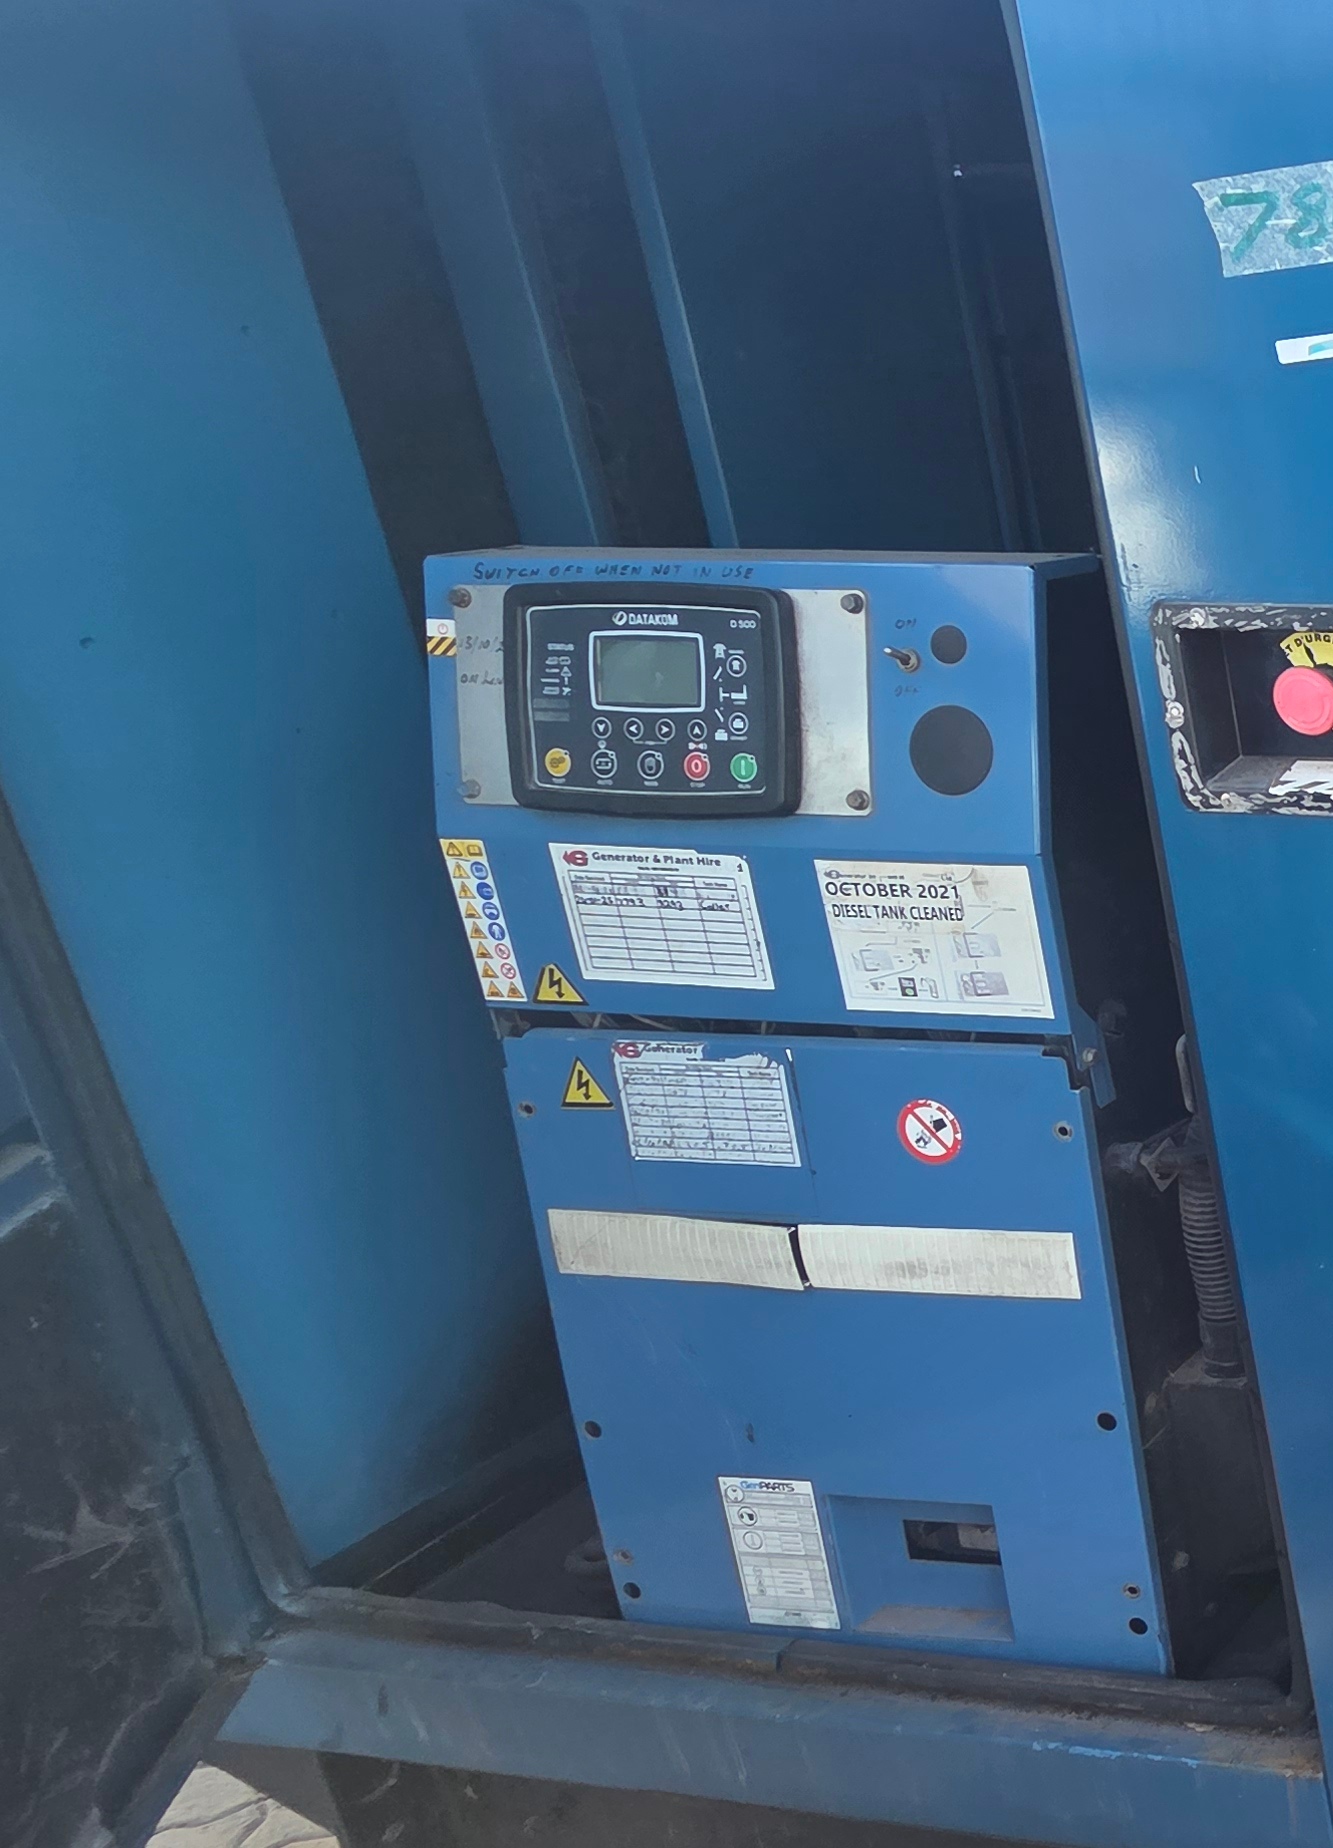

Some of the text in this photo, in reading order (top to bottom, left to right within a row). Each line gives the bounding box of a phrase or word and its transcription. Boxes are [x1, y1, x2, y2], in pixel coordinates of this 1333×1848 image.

[594, 563, 641, 576] WHEN
[651, 564, 681, 576] NOT
[721, 565, 753, 579] USE
[628, 613, 678, 626] DATAKOM
[592, 851, 649, 864] Generator
[652, 854, 661, 864] &
[663, 855, 694, 866] Plant
[697, 857, 721, 867] Hire
[825, 881, 960, 899] OCTOBER 2021
[832, 903, 964, 921] DIESEL TANK CLEANED
